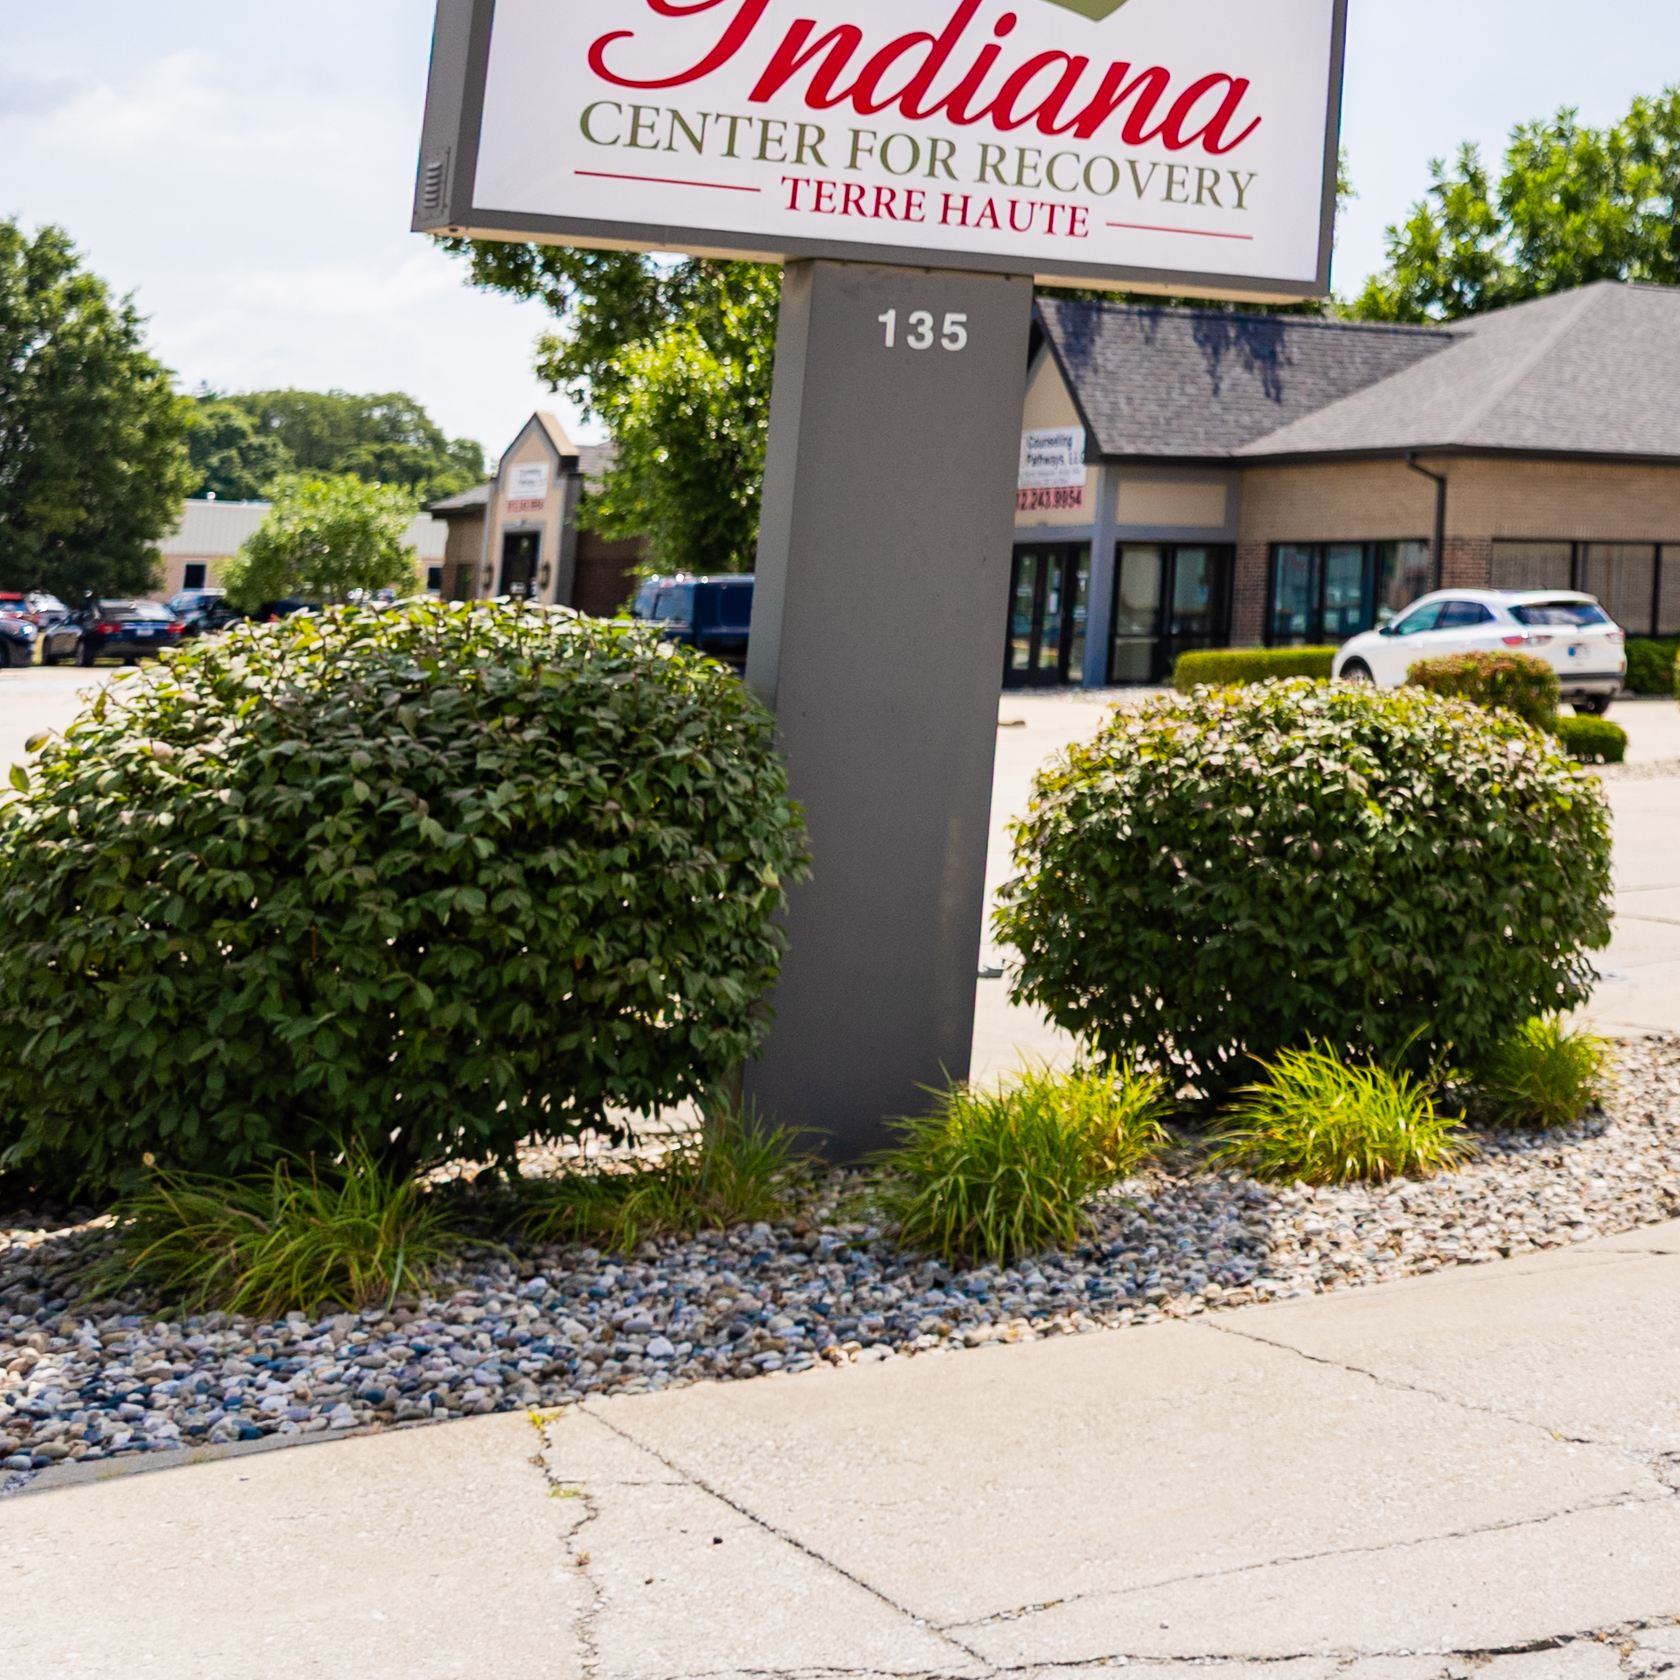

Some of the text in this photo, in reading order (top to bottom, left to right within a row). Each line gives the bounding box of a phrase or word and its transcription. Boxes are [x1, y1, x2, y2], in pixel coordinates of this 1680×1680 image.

[578, 100, 1259, 210] CENTER FOR RECOVERY
[780, 176, 1091, 239] TERRE HAUTE
[877, 308, 968, 352] 135
[1027, 434, 1073, 451] Counseling
